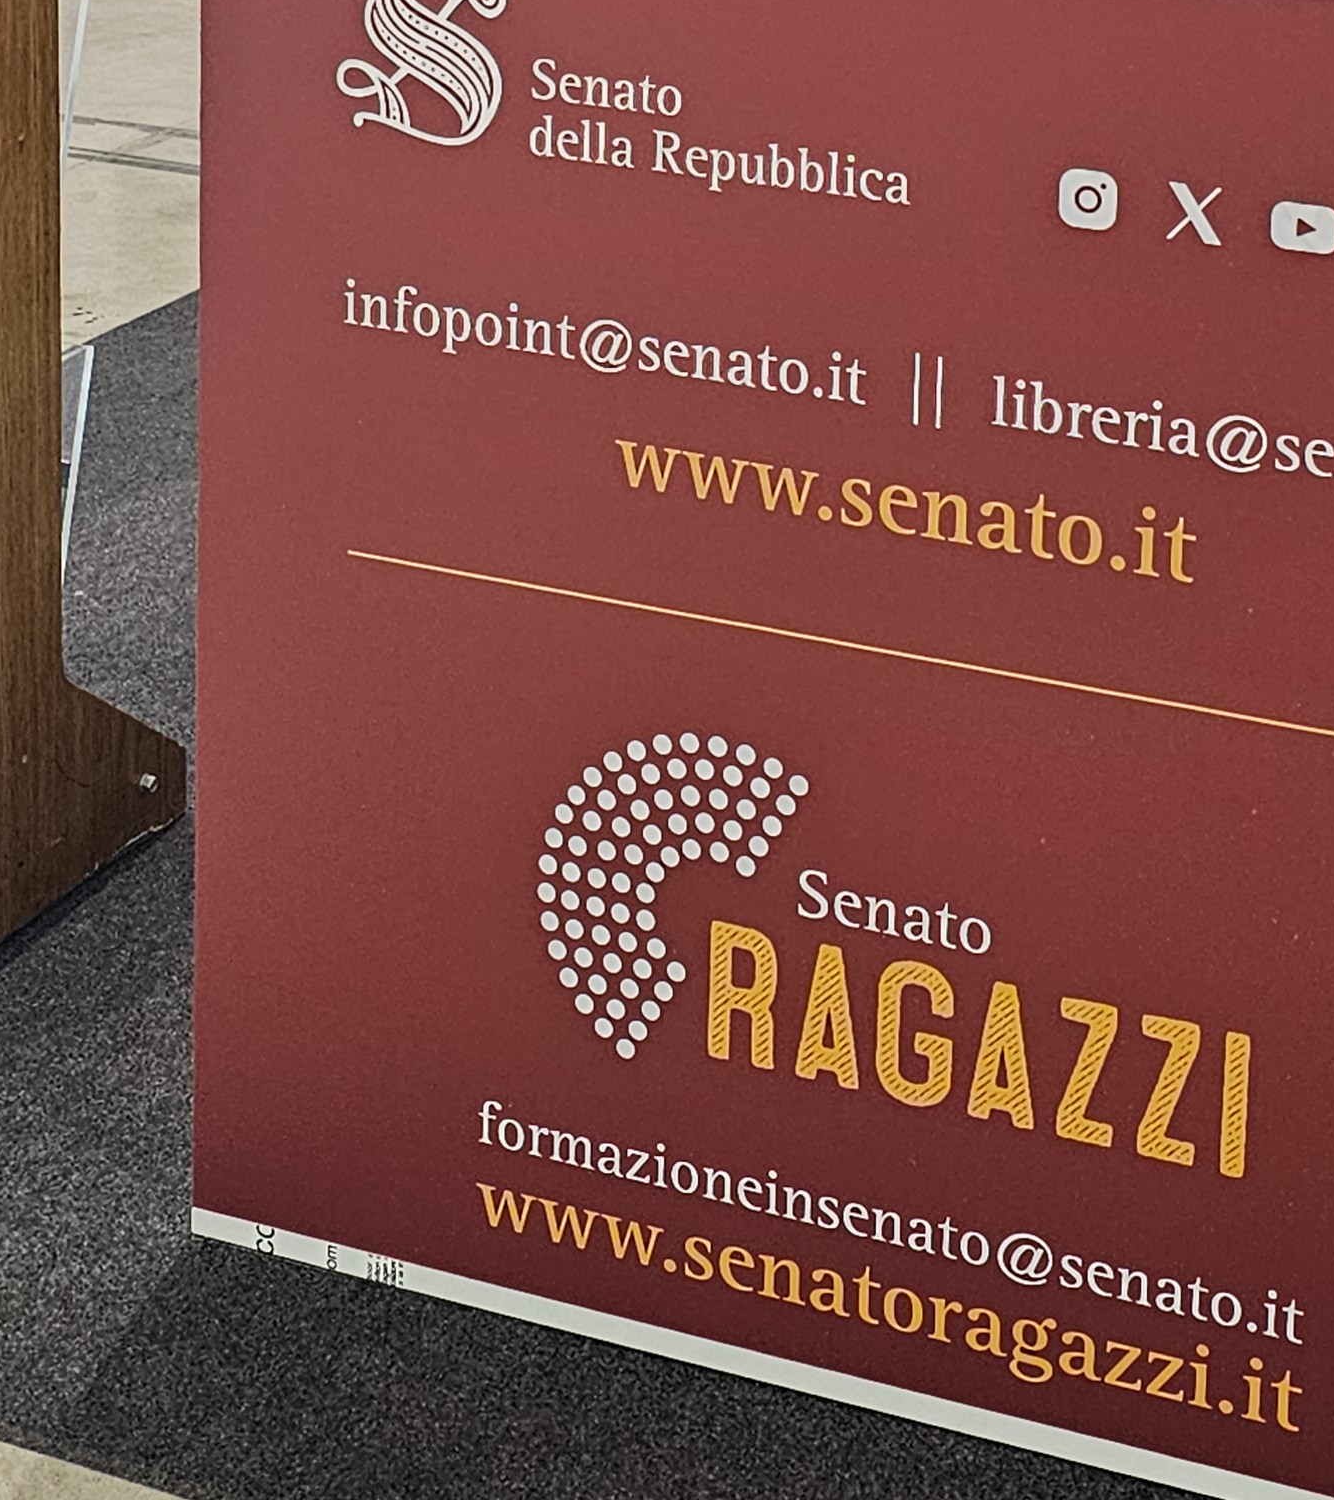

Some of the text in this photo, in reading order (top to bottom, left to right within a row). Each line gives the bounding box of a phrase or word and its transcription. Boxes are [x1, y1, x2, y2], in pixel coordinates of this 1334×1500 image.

[531, 58, 682, 116] Senato
[529, 114, 911, 205] della Repubblica
[343, 279, 867, 406] infopoint@senato.it
[614, 439, 1197, 584] www.senato.it
[797, 869, 991, 954] Senato
[707, 920, 1251, 1178] RAGAZZI
[478, 1100, 1305, 1344] formazioneinsenato@senato.it
[475, 1182, 1304, 1432] www.senatoragazzi.it
